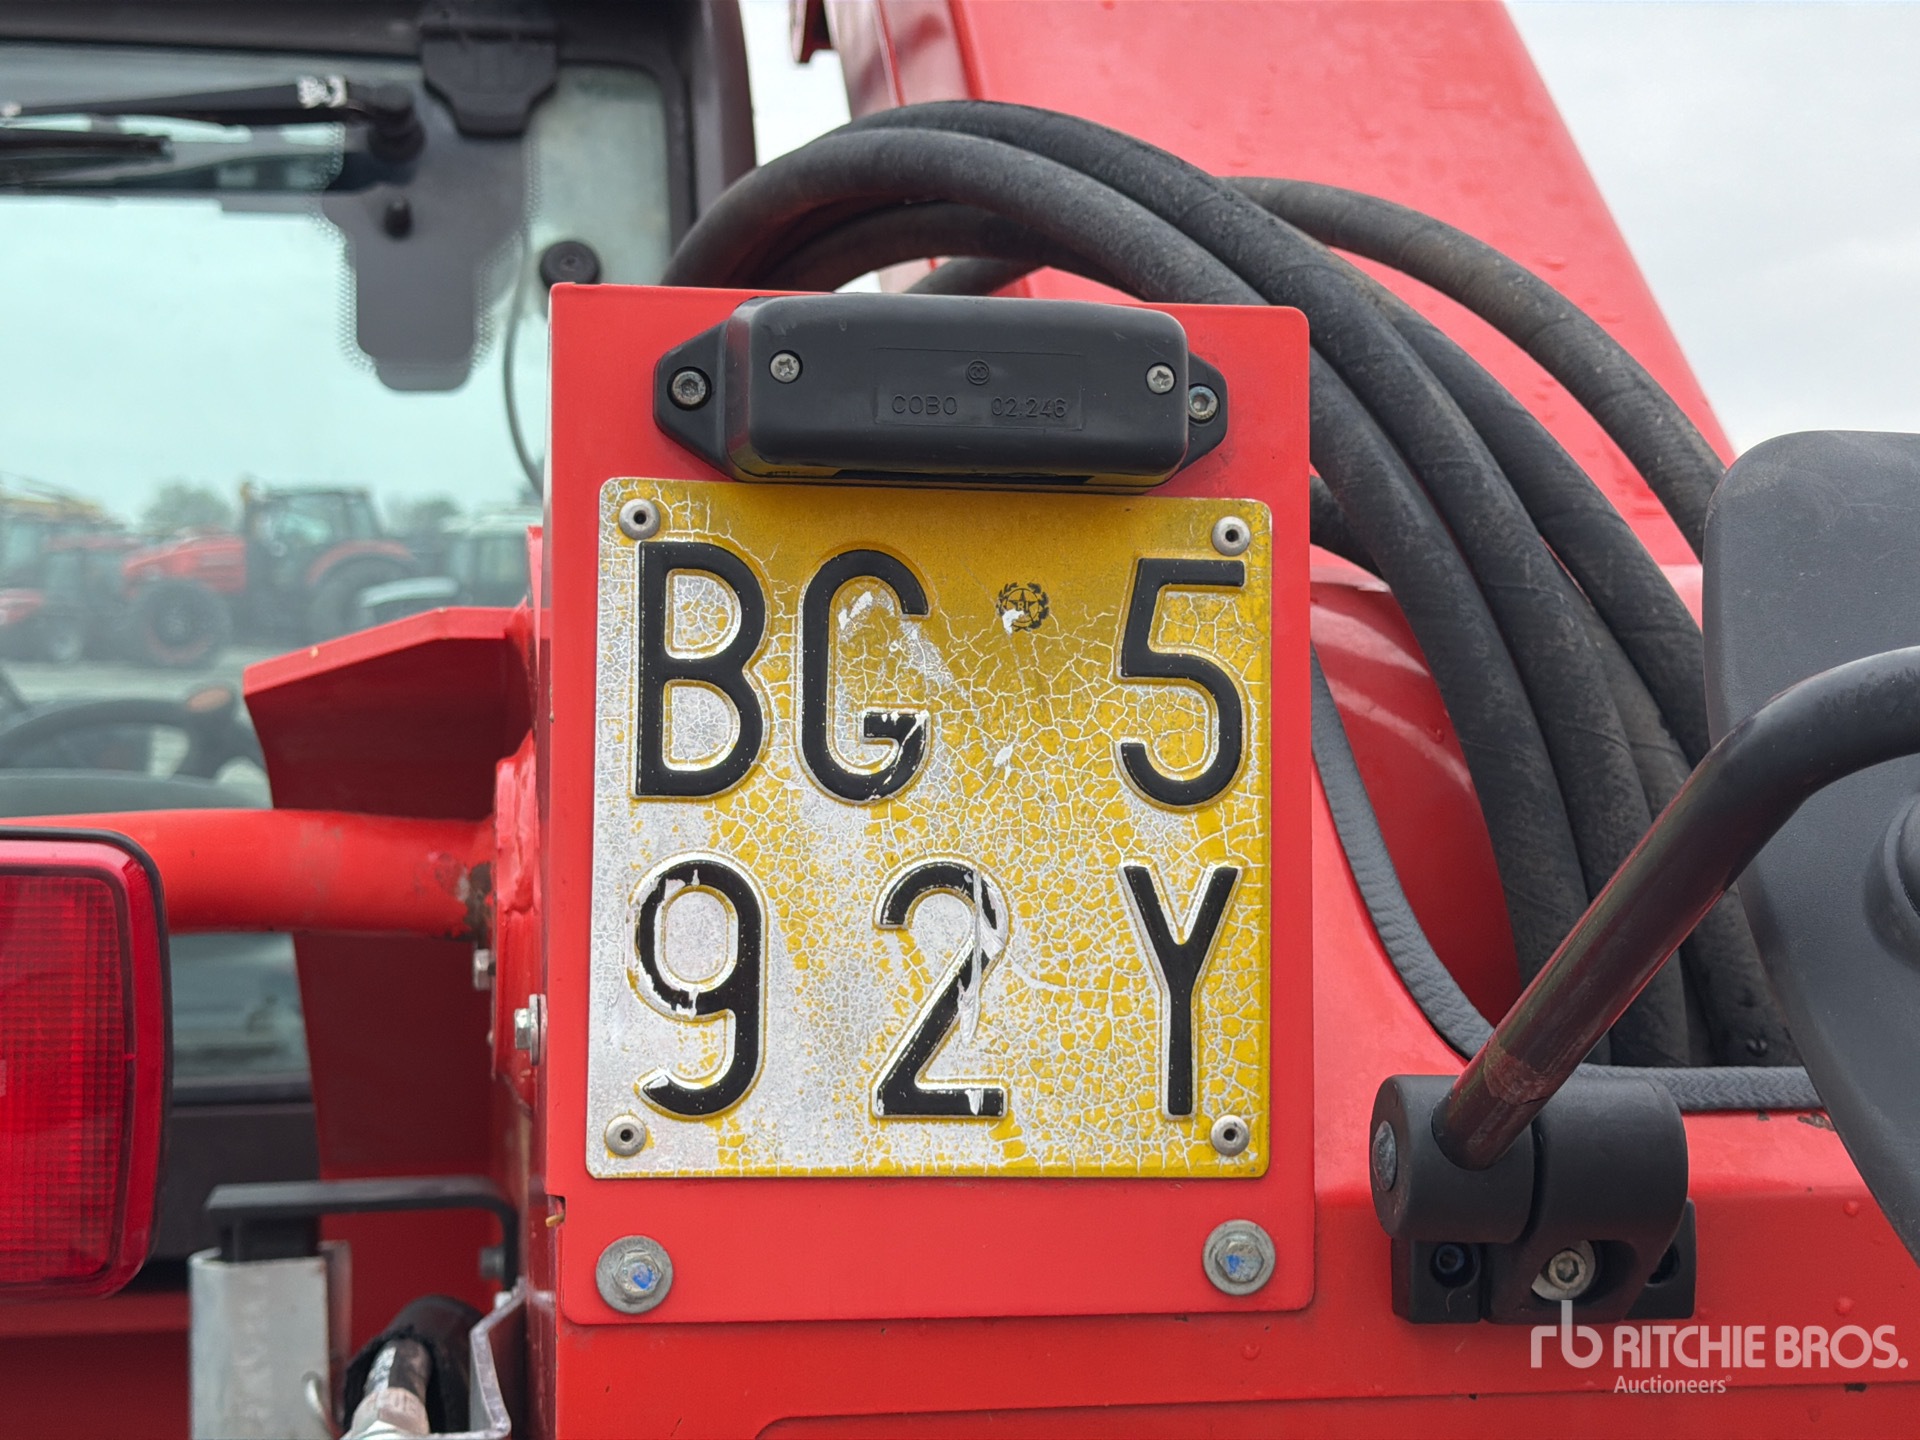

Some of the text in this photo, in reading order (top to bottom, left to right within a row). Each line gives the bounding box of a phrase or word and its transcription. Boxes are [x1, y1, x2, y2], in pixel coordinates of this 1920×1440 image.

[891, 394, 1067, 418] COBO 02.246
[634, 540, 1245, 808] BG 5
